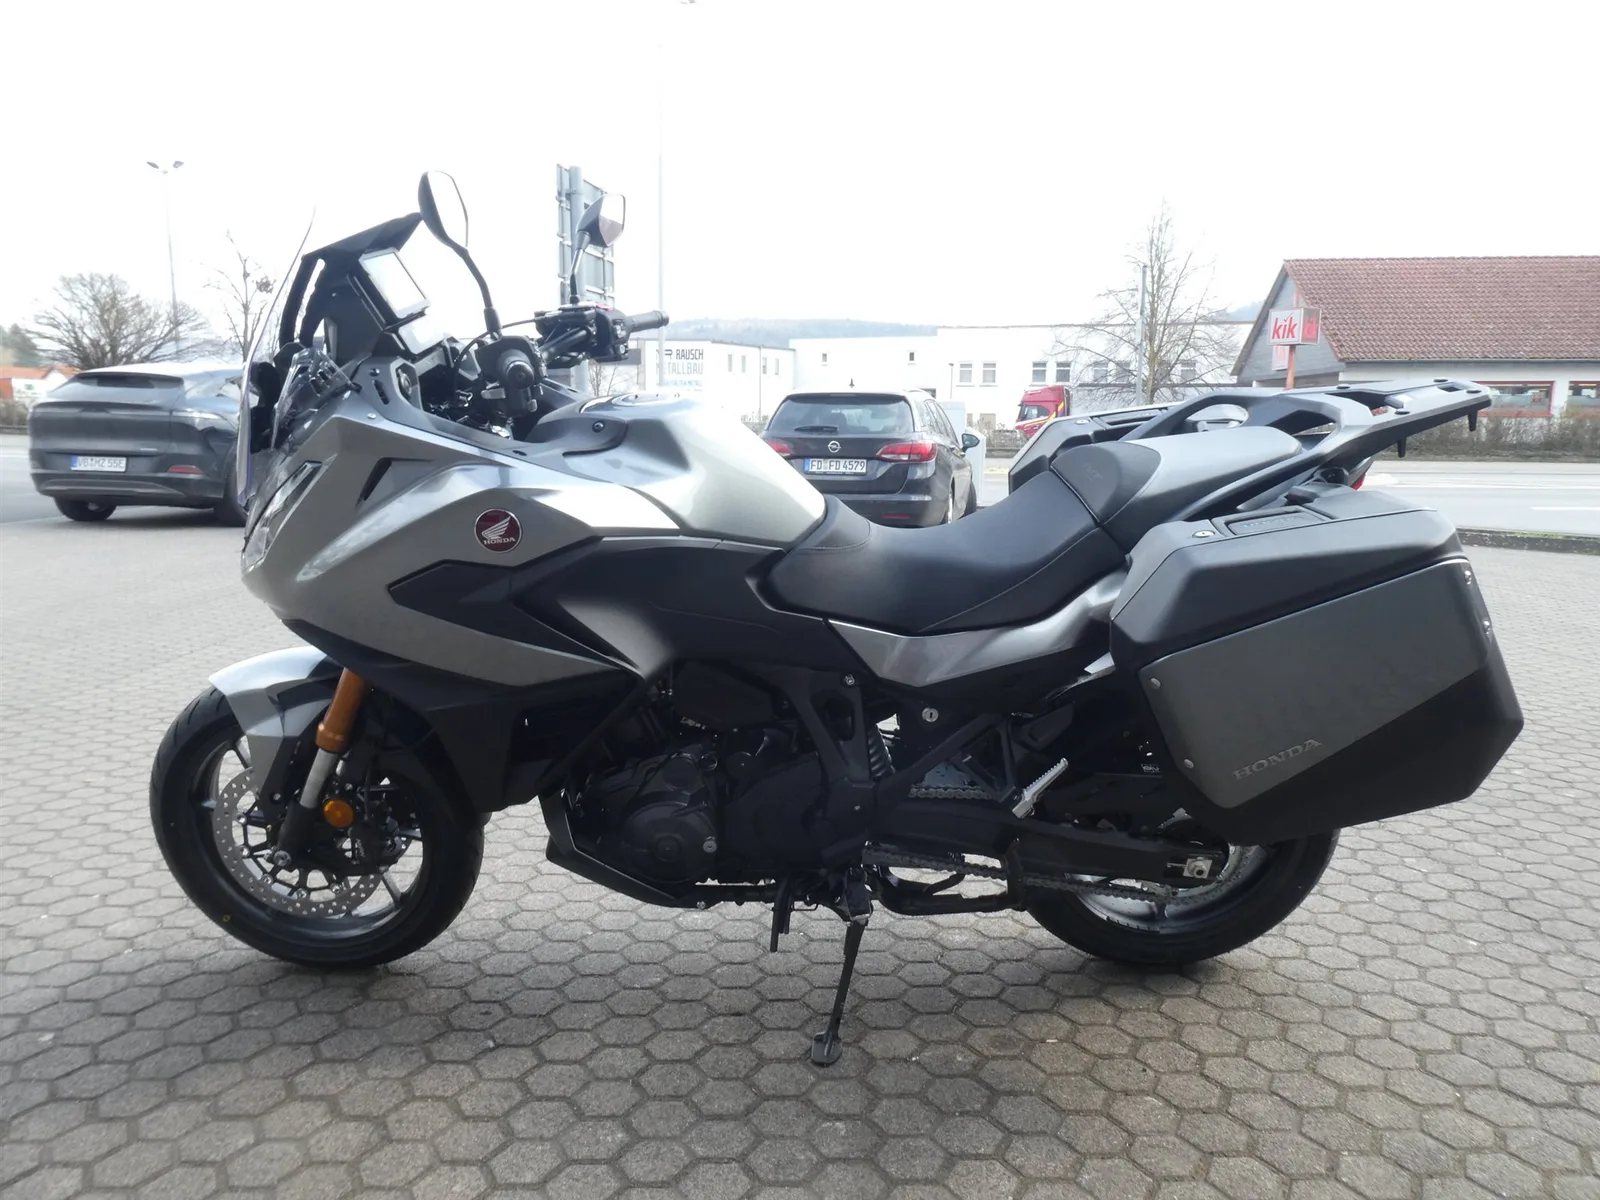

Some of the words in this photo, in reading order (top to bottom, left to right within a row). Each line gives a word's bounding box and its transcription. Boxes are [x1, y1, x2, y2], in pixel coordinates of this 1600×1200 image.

[675, 348, 704, 360] RAUSCH
[656, 361, 704, 375] MTALLBAU
[810, 459, 823, 470] FD
[828, 459, 841, 470] FD
[842, 460, 866, 471] 4579
[483, 537, 516, 545] HONDA
[1232, 738, 1322, 780] HONDA
